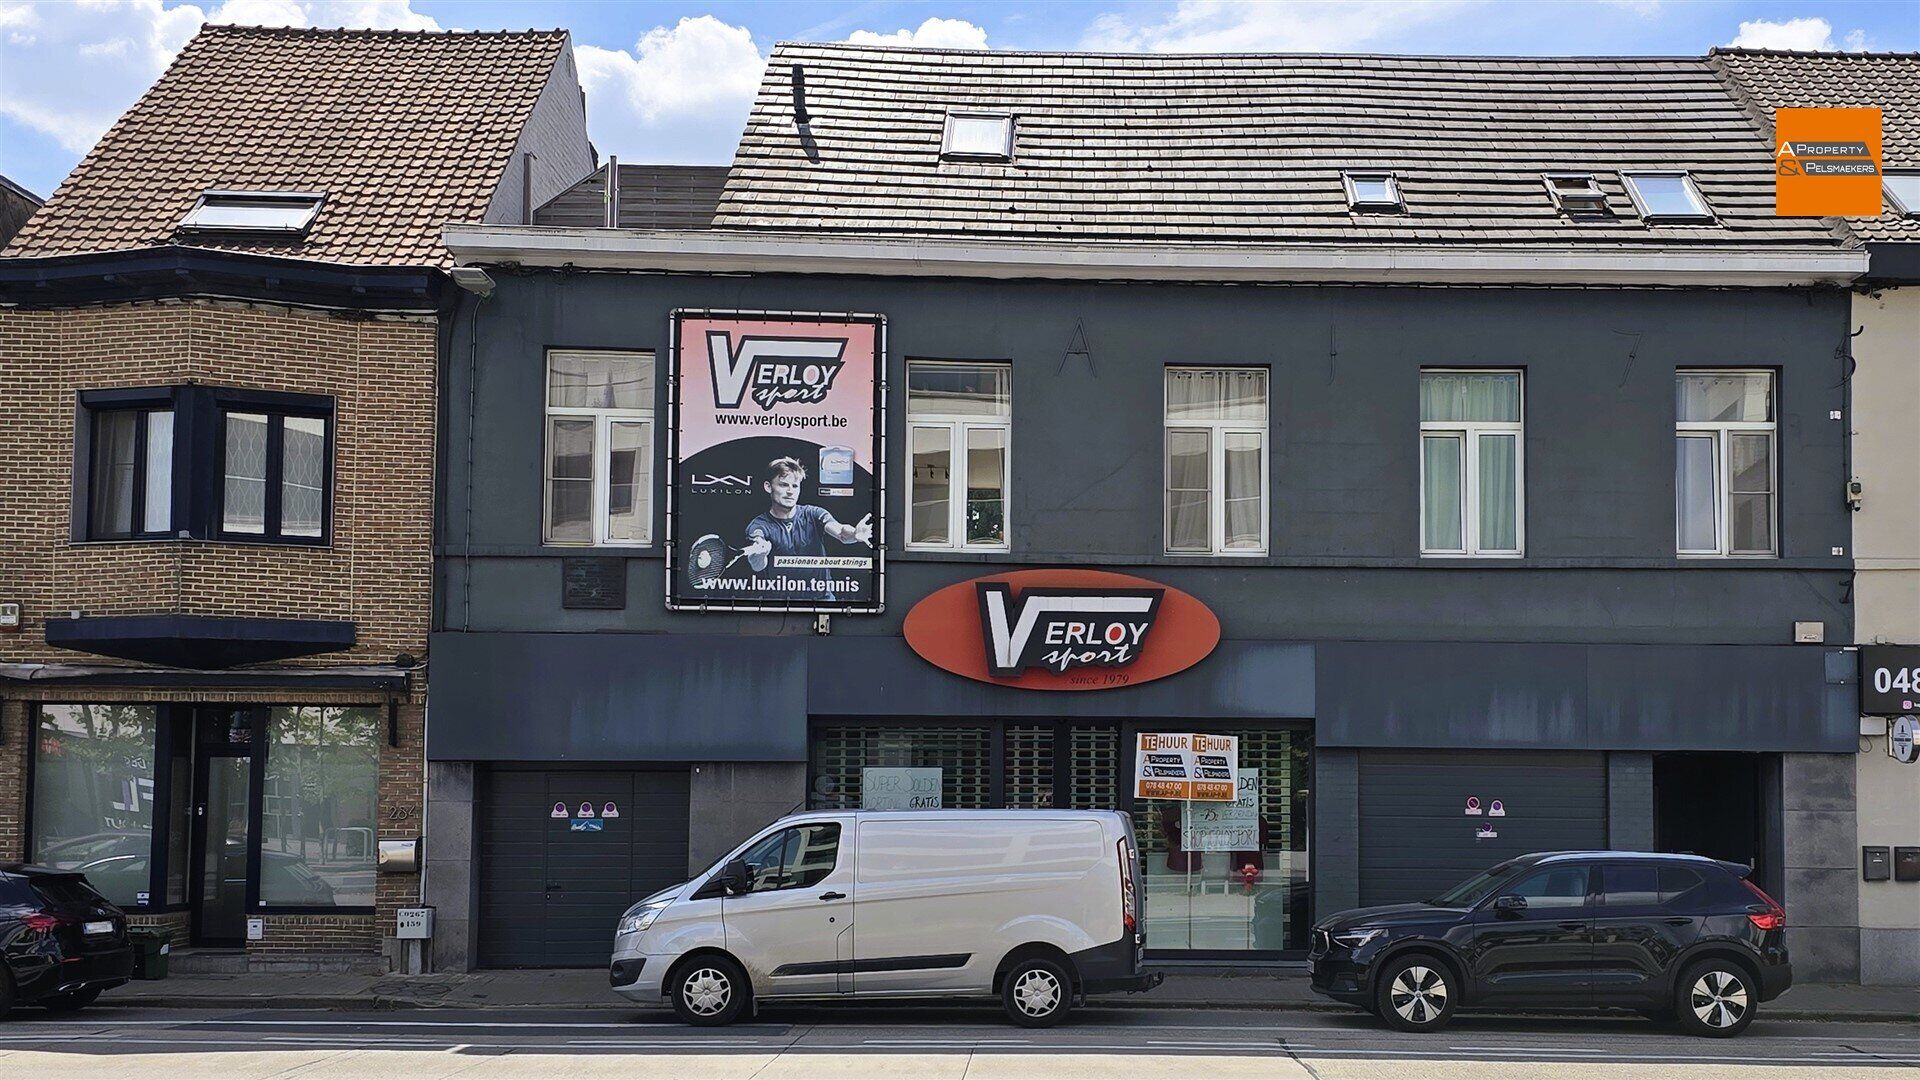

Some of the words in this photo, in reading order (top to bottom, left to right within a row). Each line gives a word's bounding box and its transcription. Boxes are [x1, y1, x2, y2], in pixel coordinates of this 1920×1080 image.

[710, 335, 843, 405] VERLOY
[756, 382, 824, 407] sport
[715, 413, 848, 429] www.verloysport.be
[777, 558, 818, 567] passionate
[819, 558, 841, 566] about
[842, 558, 868, 567] strings
[702, 575, 860, 593] www.luxilon.tennis
[985, 590, 1154, 668] VERLOY
[1041, 643, 1134, 671] sport
[1070, 674, 1099, 685] since
[1102, 674, 1130, 685] 1979
[1145, 736, 1157, 749] TE
[1158, 736, 1188, 749] HUUR
[1195, 737, 1206, 751] TE
[1206, 738, 1232, 751] HUUR
[865, 770, 901, 792] SUPER
[909, 796, 940, 809] GRATIS
